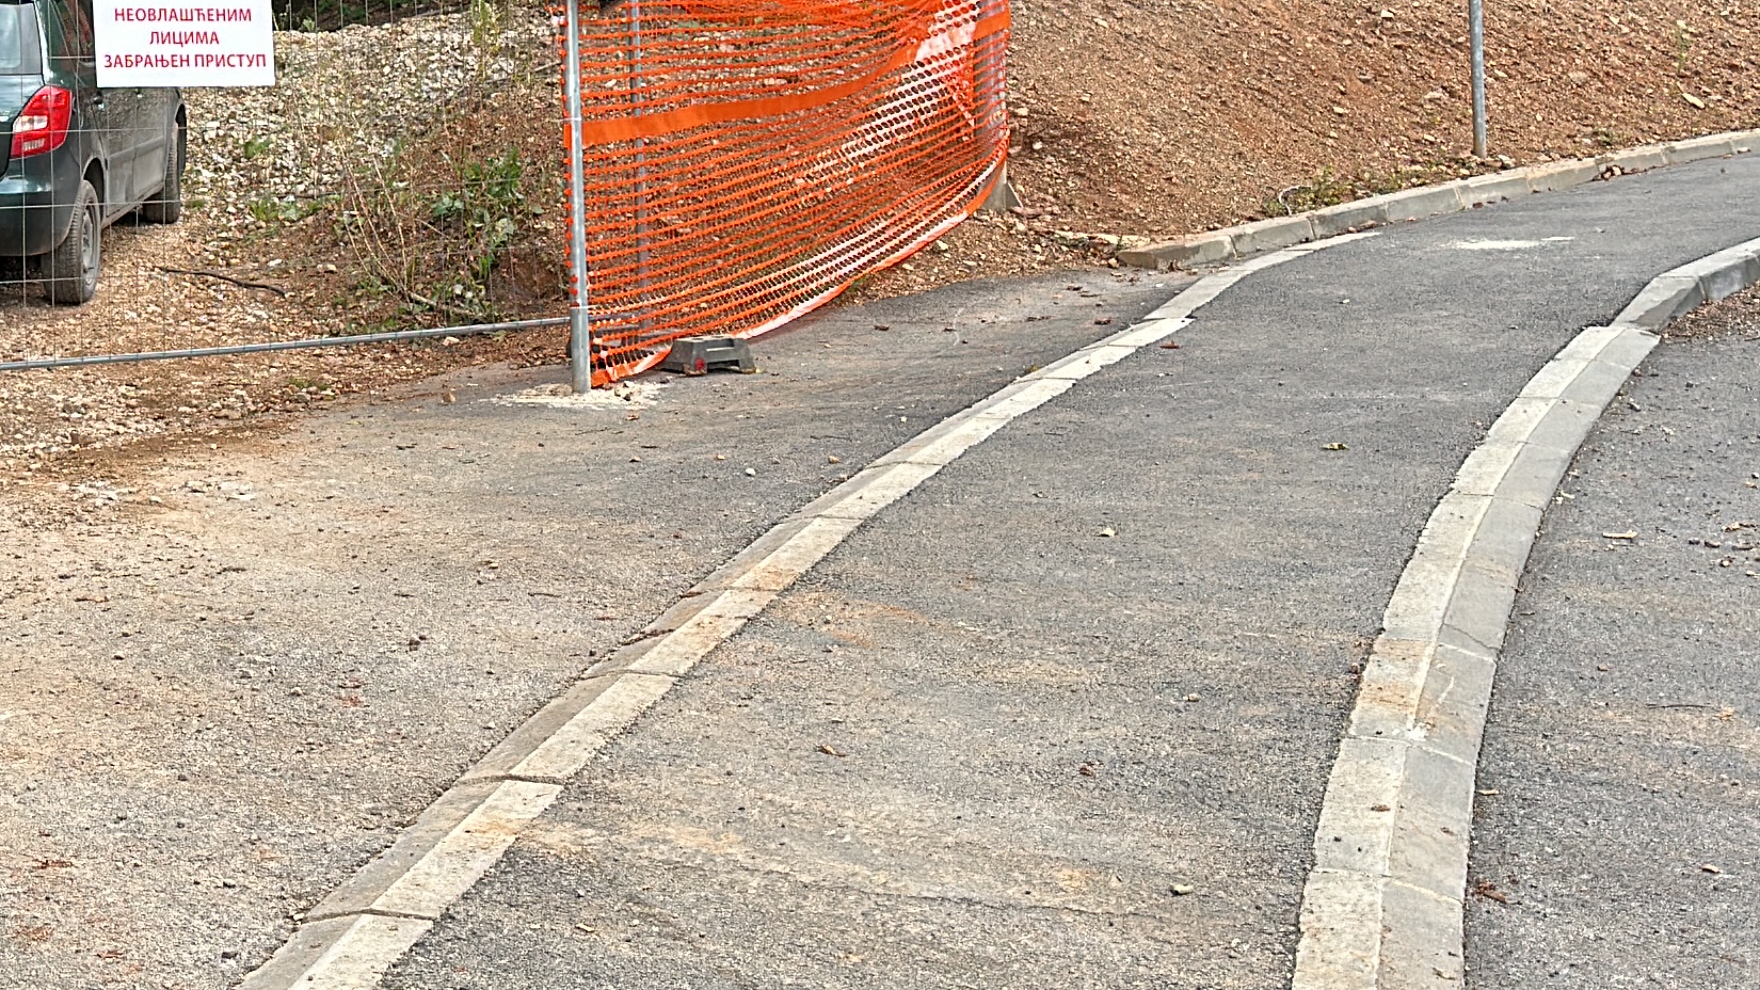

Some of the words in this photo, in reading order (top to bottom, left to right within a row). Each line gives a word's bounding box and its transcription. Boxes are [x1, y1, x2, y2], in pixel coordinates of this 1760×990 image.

[114, 8, 252, 22] НЕОВЛАШЋЕНИМ
[149, 31, 220, 47] ЛИЦИМА
[103, 54, 190, 68] ЗАБРАЊЕН
[194, 53, 267, 68] ПРИСТУП
